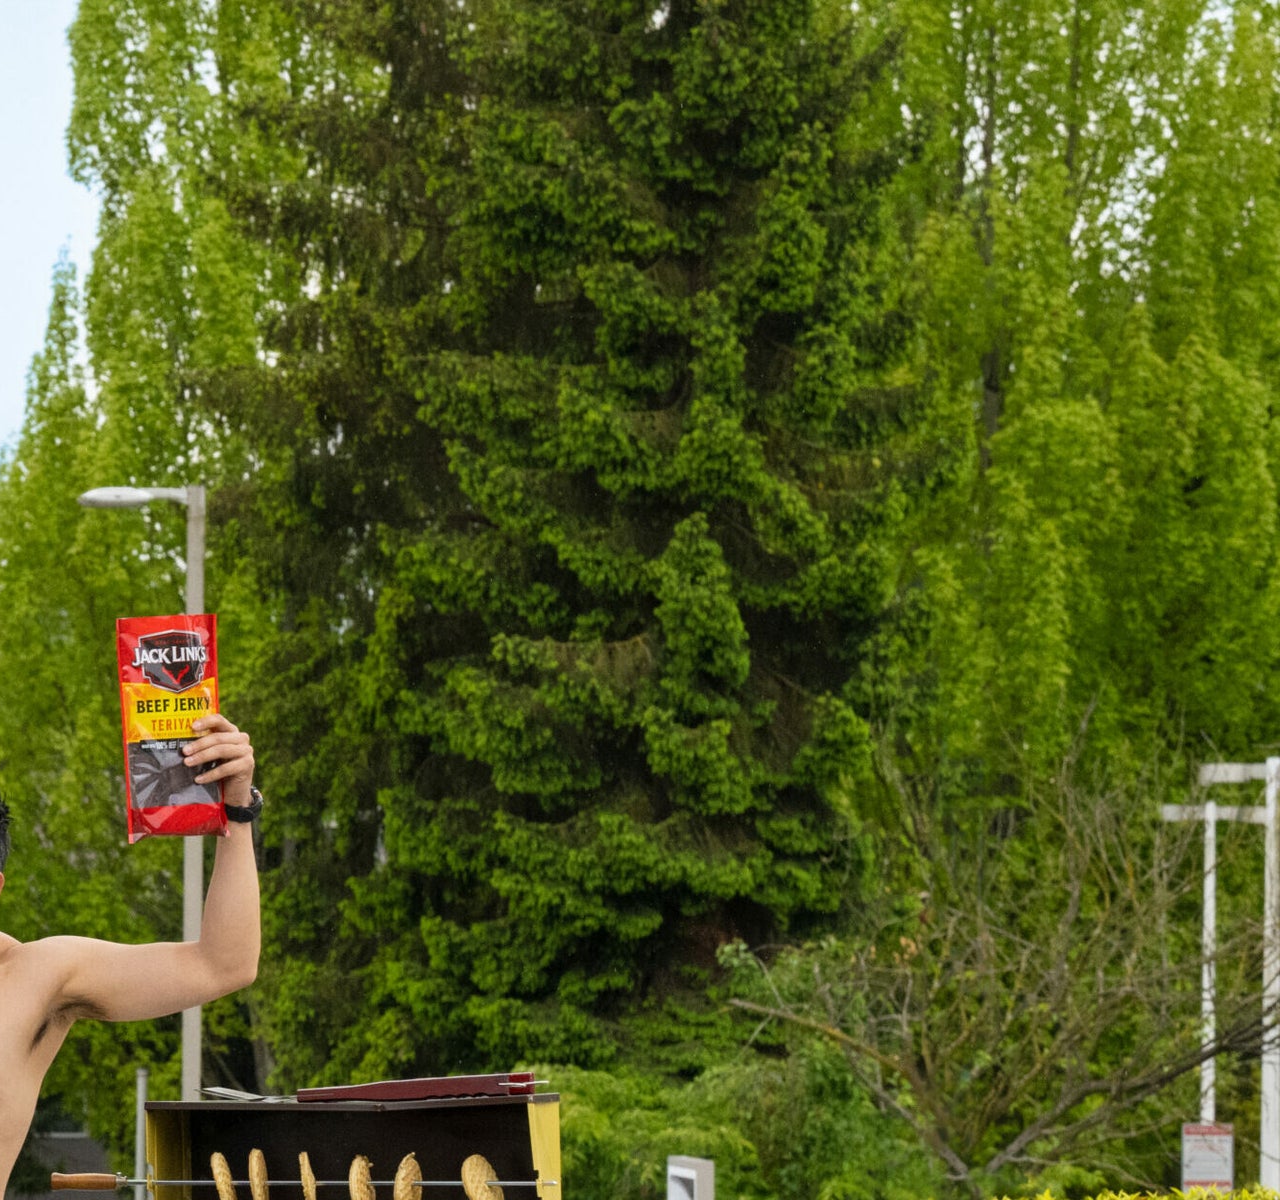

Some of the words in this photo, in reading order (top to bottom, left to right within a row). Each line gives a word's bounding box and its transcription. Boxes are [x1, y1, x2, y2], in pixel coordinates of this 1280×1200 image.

[132, 647, 172, 666] JACK
[137, 699, 170, 713] BEEF
[174, 696, 210, 712] JERKY
[151, 718, 197, 731] TERIYA
